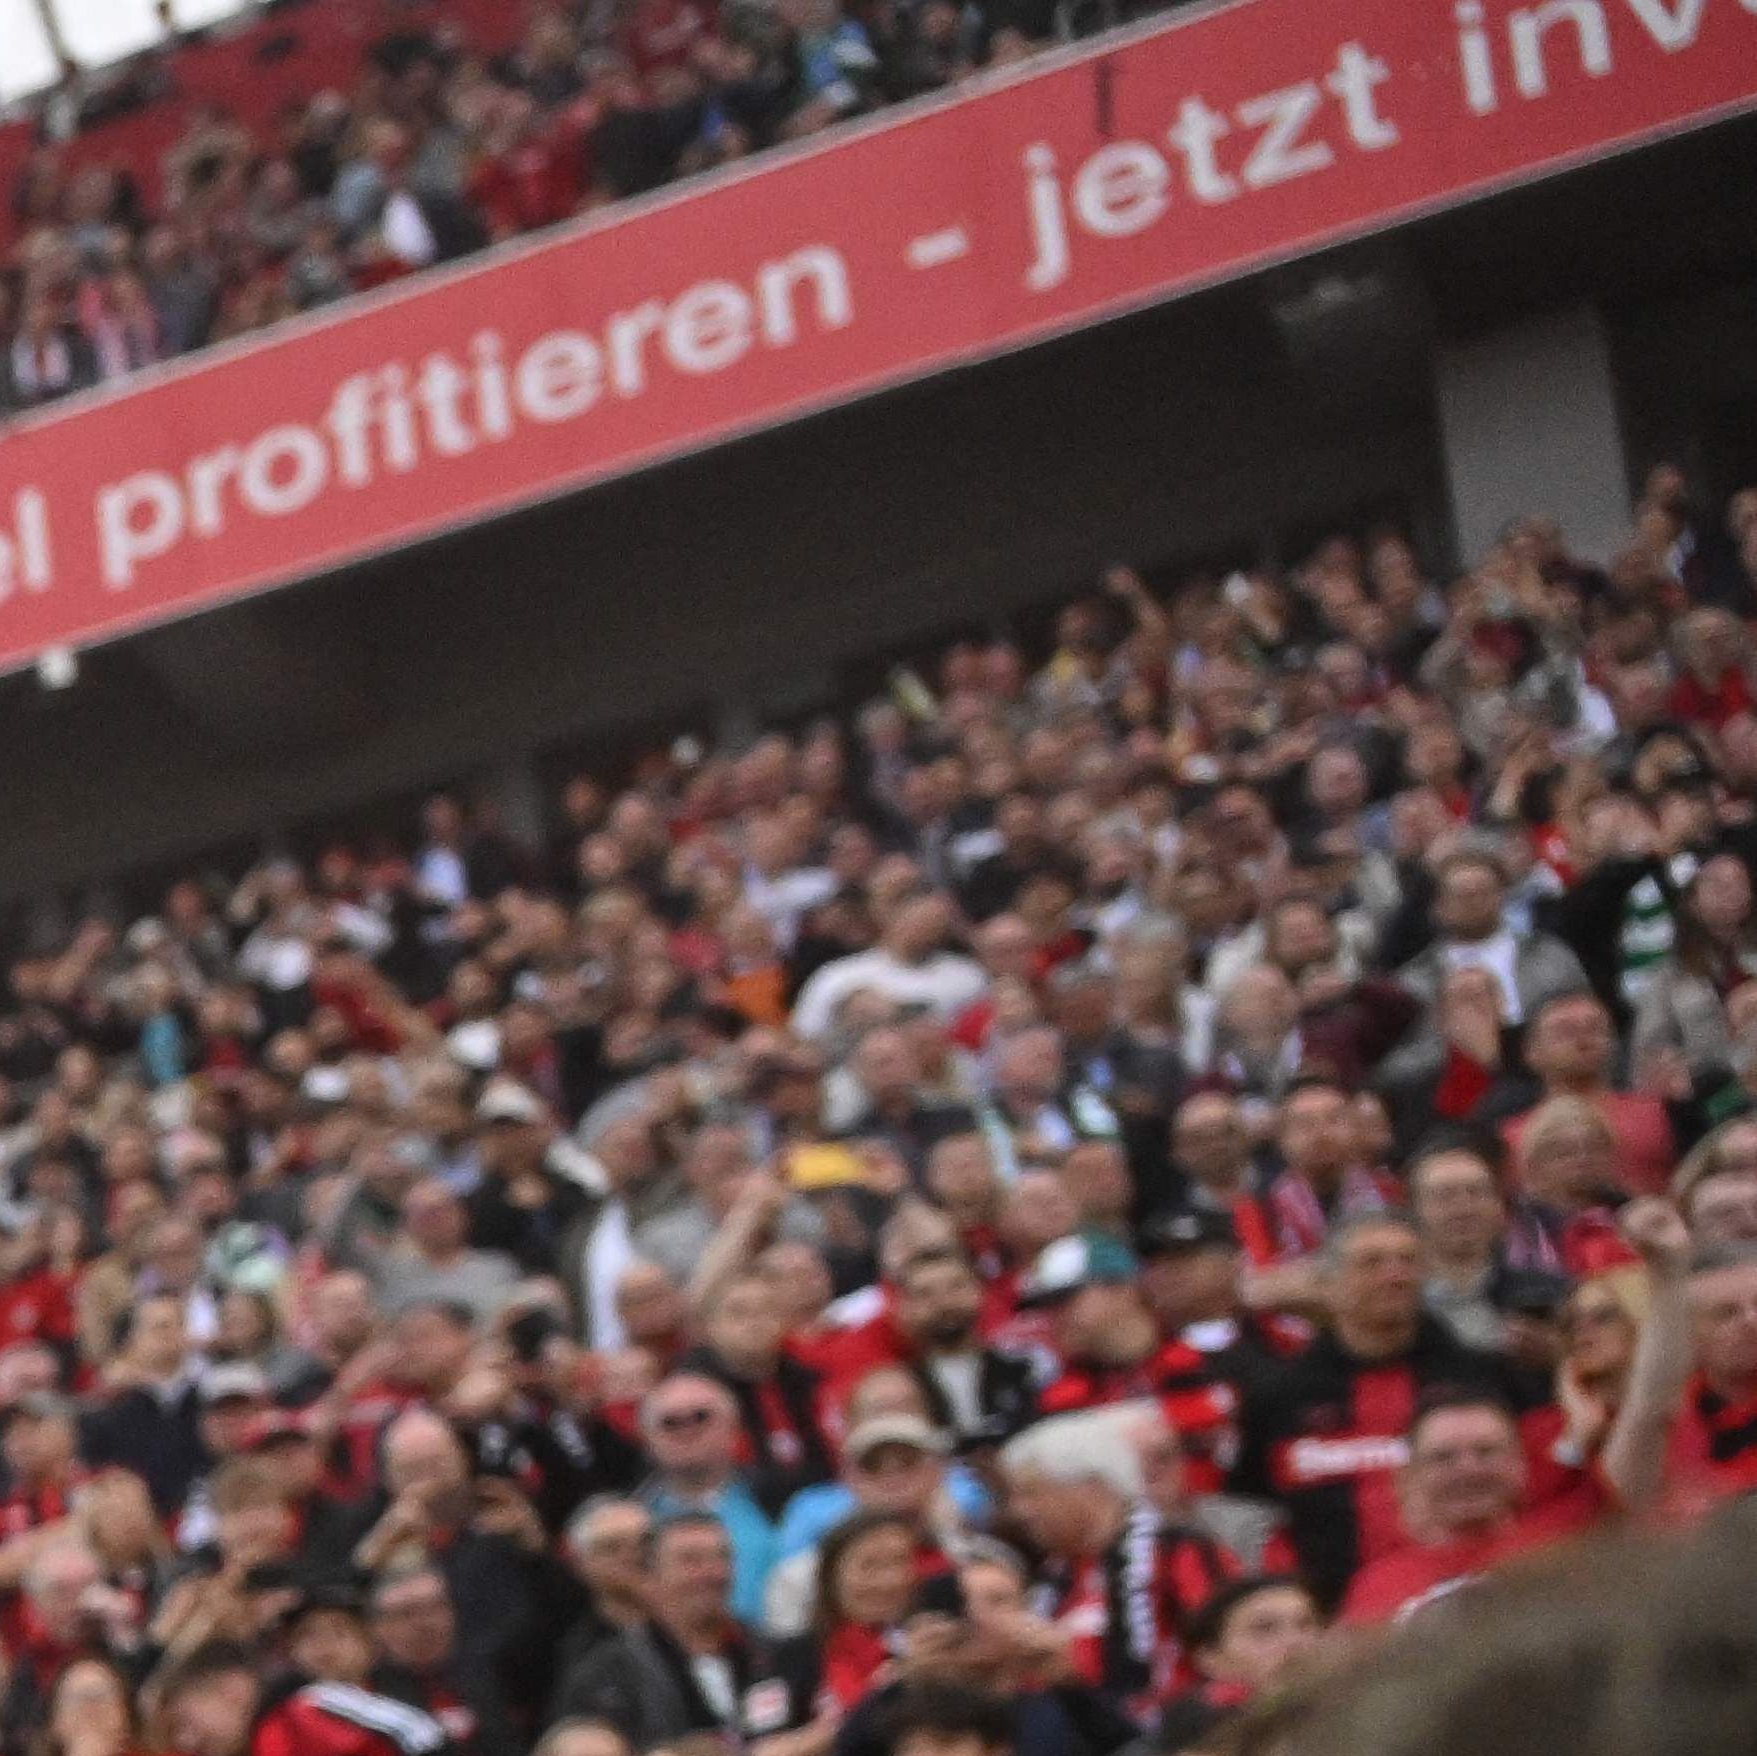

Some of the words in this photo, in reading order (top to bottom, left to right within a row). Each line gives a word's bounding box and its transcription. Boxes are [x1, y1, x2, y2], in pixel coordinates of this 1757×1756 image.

[94, 242, 854, 591] profitieren
[1023, 40, 1401, 292] jetzt
[1456, 0, 1757, 116] inv
